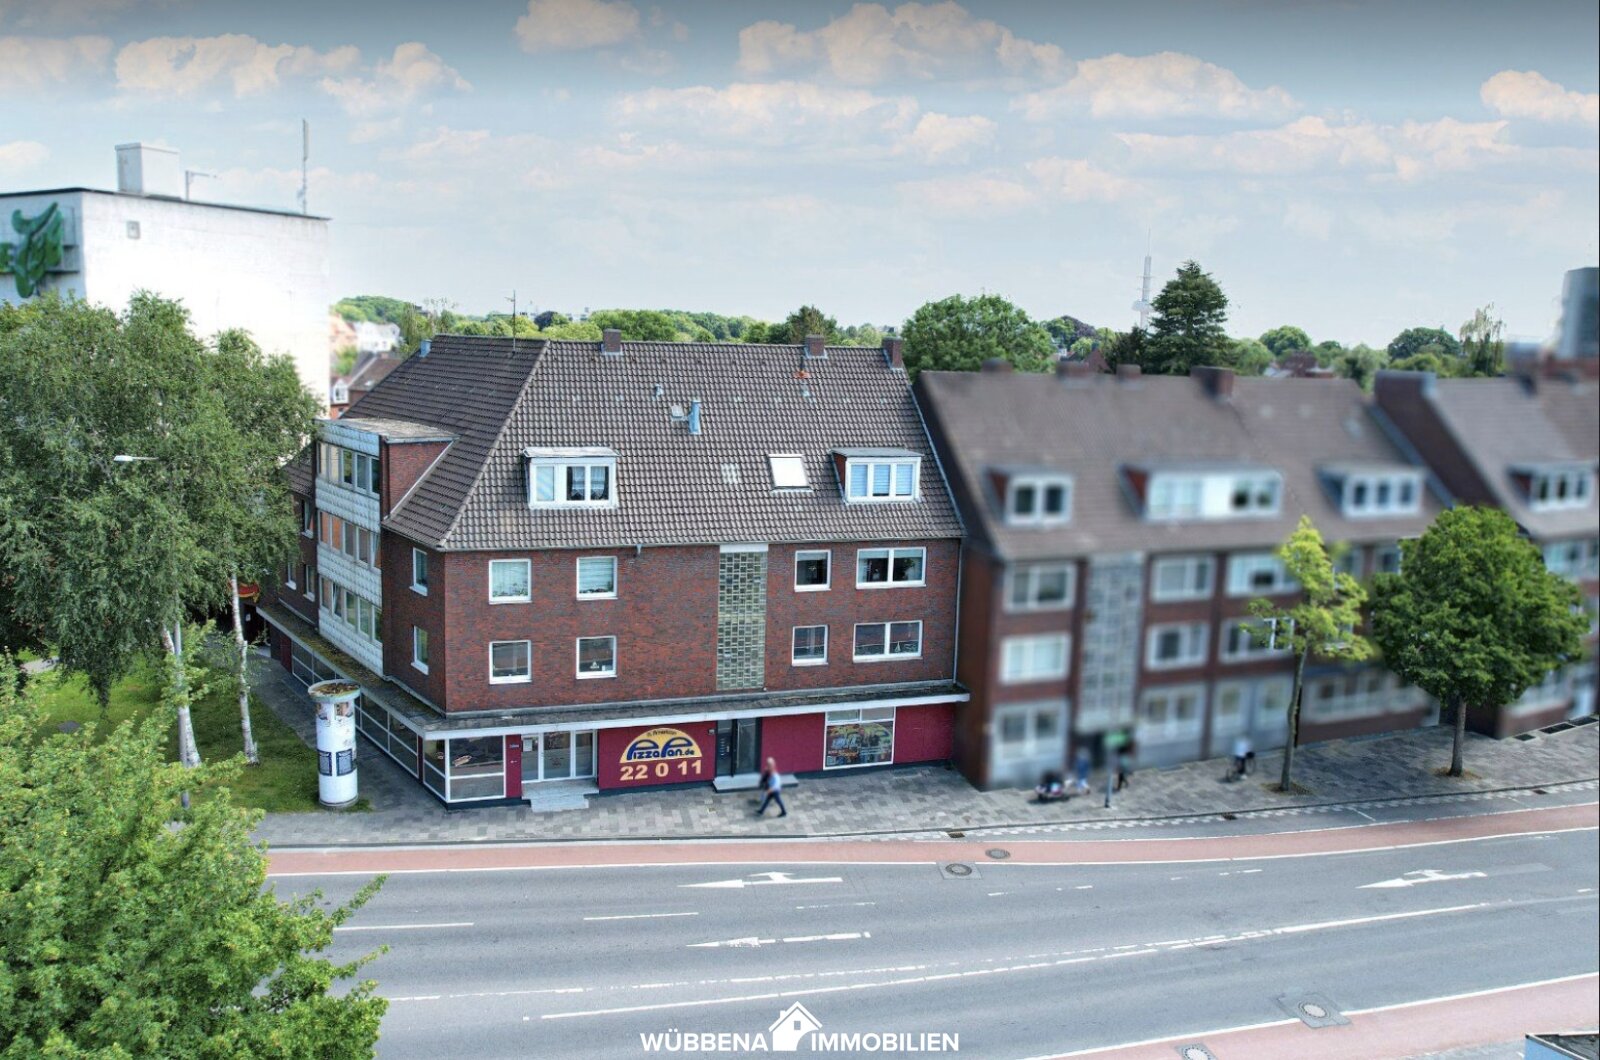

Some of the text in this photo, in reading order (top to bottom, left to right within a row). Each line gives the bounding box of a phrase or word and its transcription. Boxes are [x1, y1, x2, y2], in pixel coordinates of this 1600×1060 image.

[620, 760, 702, 781] 22 0 11
